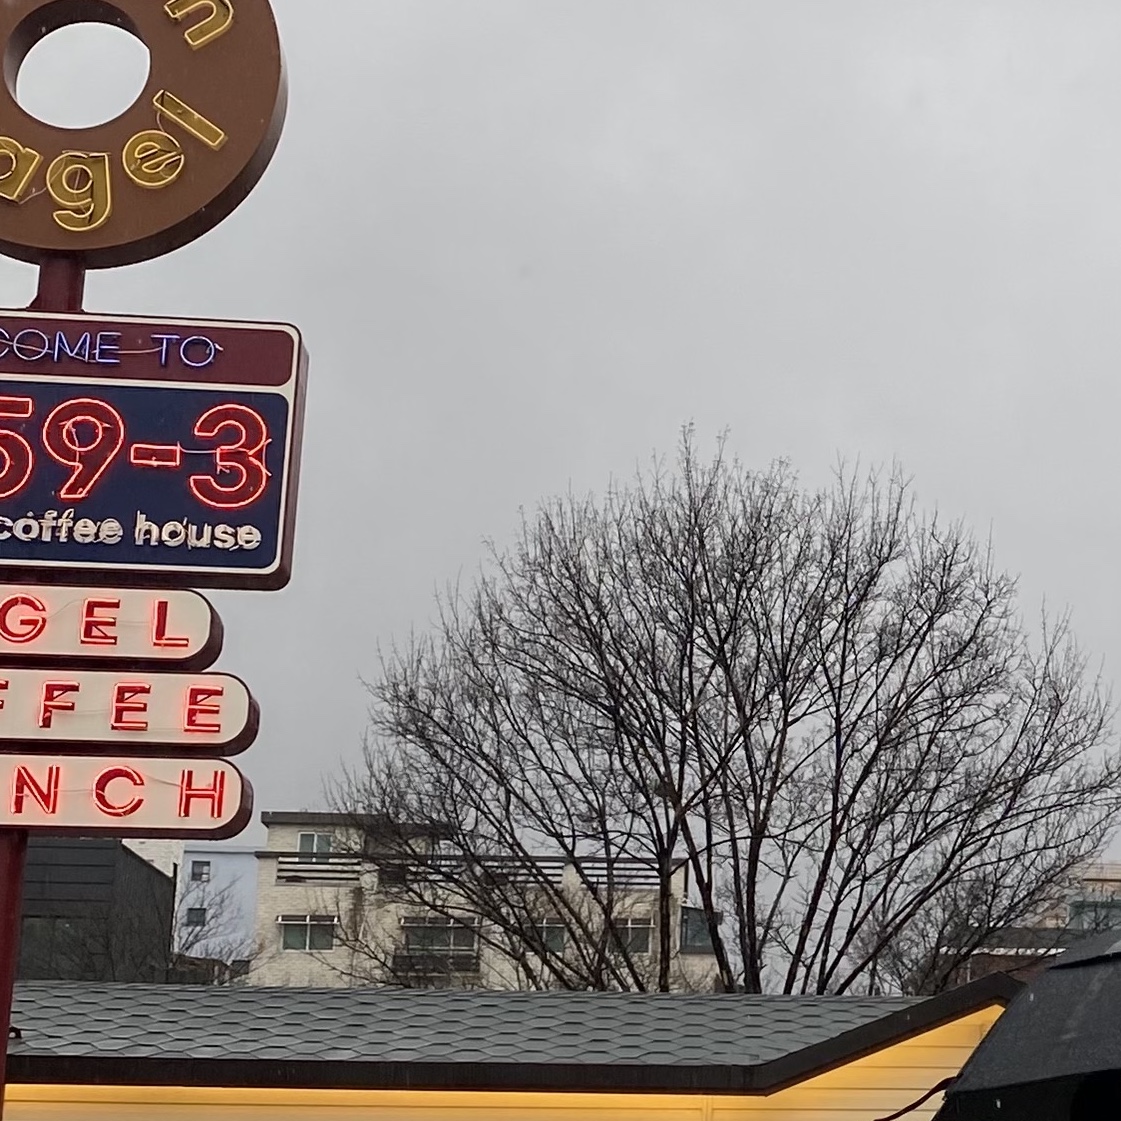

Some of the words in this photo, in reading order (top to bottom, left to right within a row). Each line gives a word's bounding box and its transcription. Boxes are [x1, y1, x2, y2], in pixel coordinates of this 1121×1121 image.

[150, 334, 216, 367] TO
[134, 510, 262, 551] house
[0, 593, 190, 648] GEL
[0, 680, 224, 733] FEE
[10, 764, 226, 819] NCH
